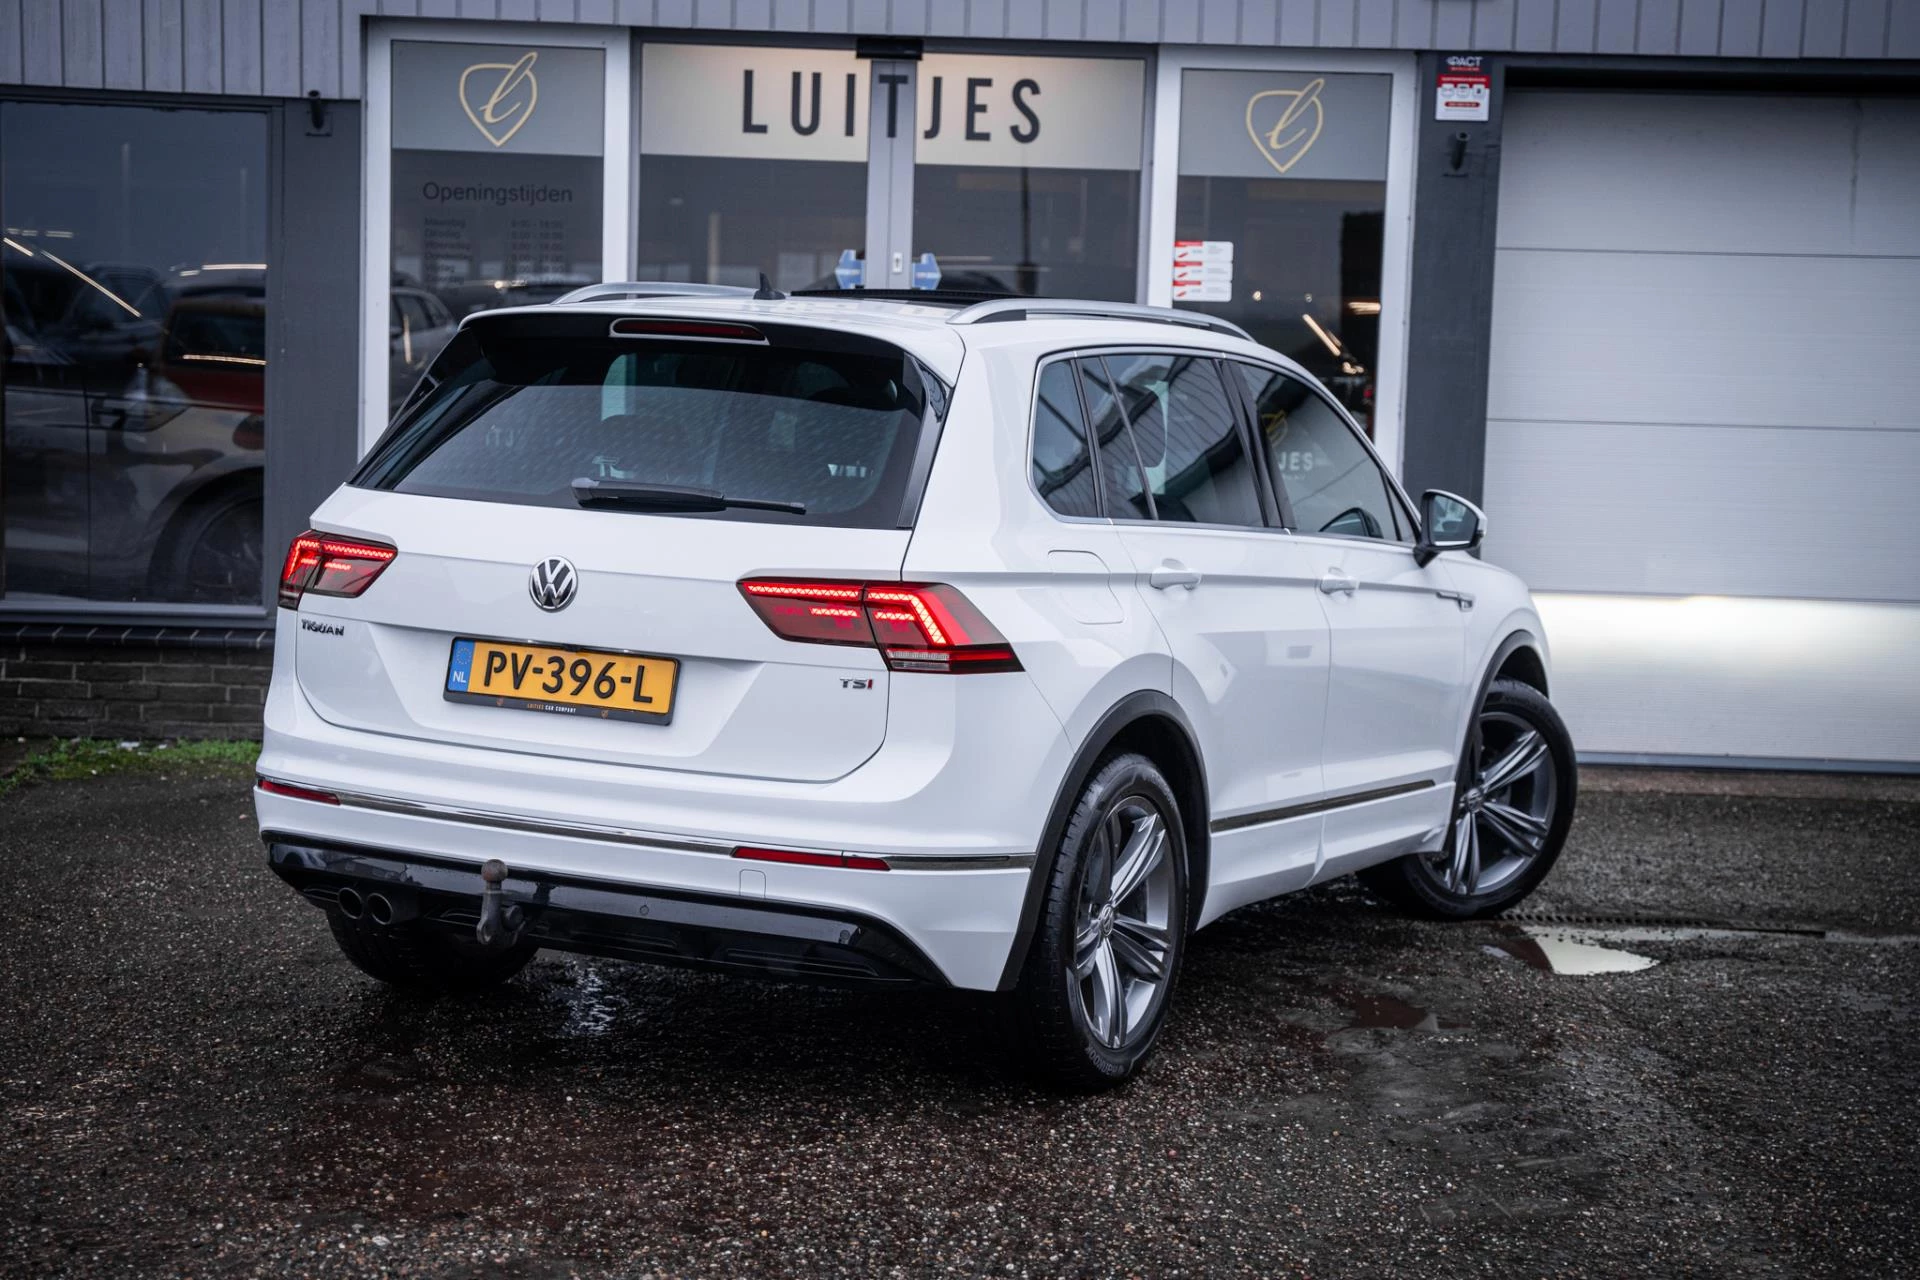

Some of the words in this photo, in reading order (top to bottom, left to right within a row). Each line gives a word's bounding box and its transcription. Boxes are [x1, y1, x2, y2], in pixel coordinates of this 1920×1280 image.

[742, 69, 1041, 144] LUITJES
[422, 181, 573, 206] Openingstijden
[301, 618, 345, 637] TIGUAN
[452, 671, 467, 684] NL
[483, 650, 653, 704] PV-396-L
[840, 677, 873, 690] TSI
